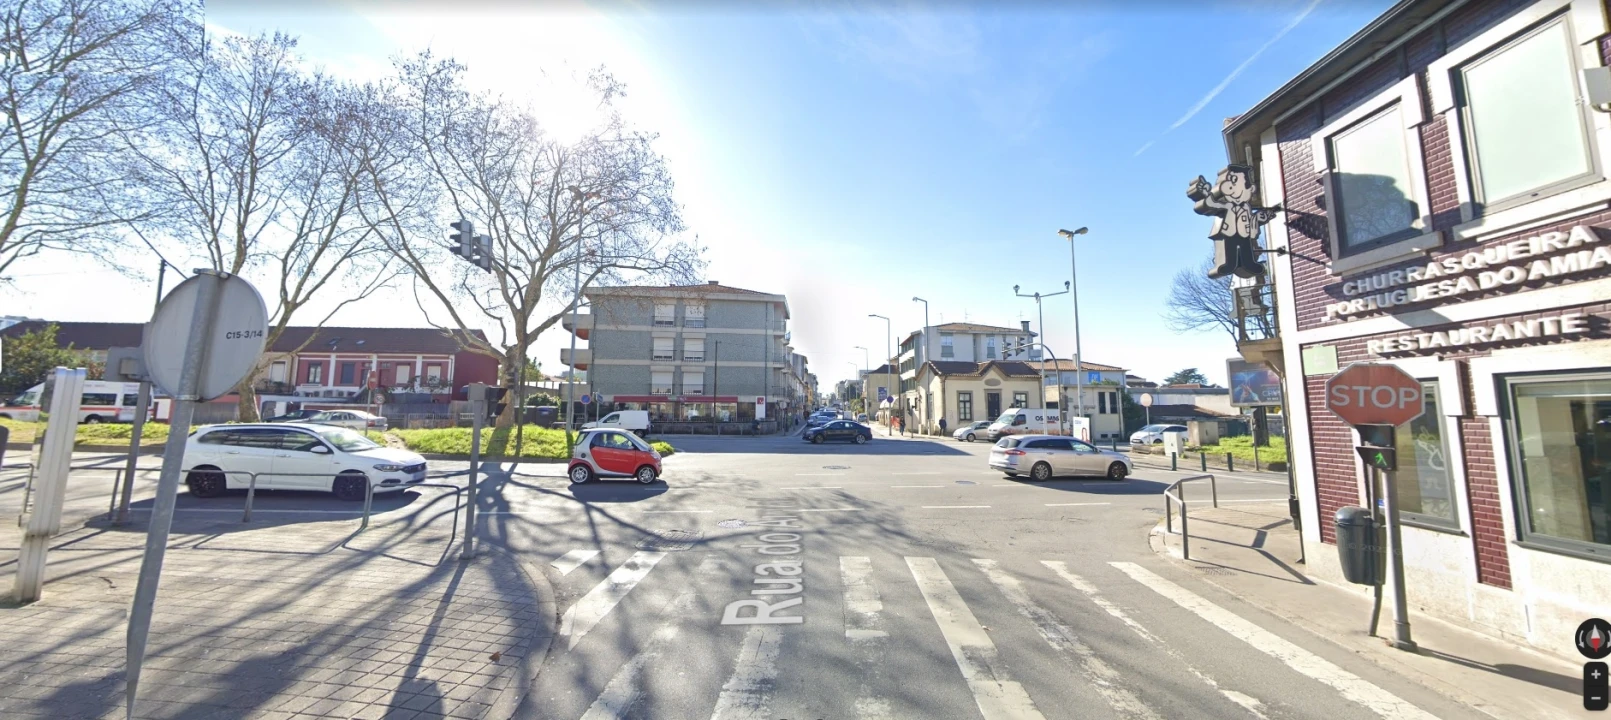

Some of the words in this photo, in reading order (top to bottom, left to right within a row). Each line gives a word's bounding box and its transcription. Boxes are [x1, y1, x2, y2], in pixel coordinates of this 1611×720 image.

[1342, 225, 1599, 297] CHURRASQUEIRA
[1326, 275, 1480, 319] PORTUGUESA
[1479, 265, 1527, 290] DO
[225, 330, 263, 340] C15-3/14
[1367, 312, 1590, 355] RESTAURANTE
[1330, 384, 1420, 410] STOP
